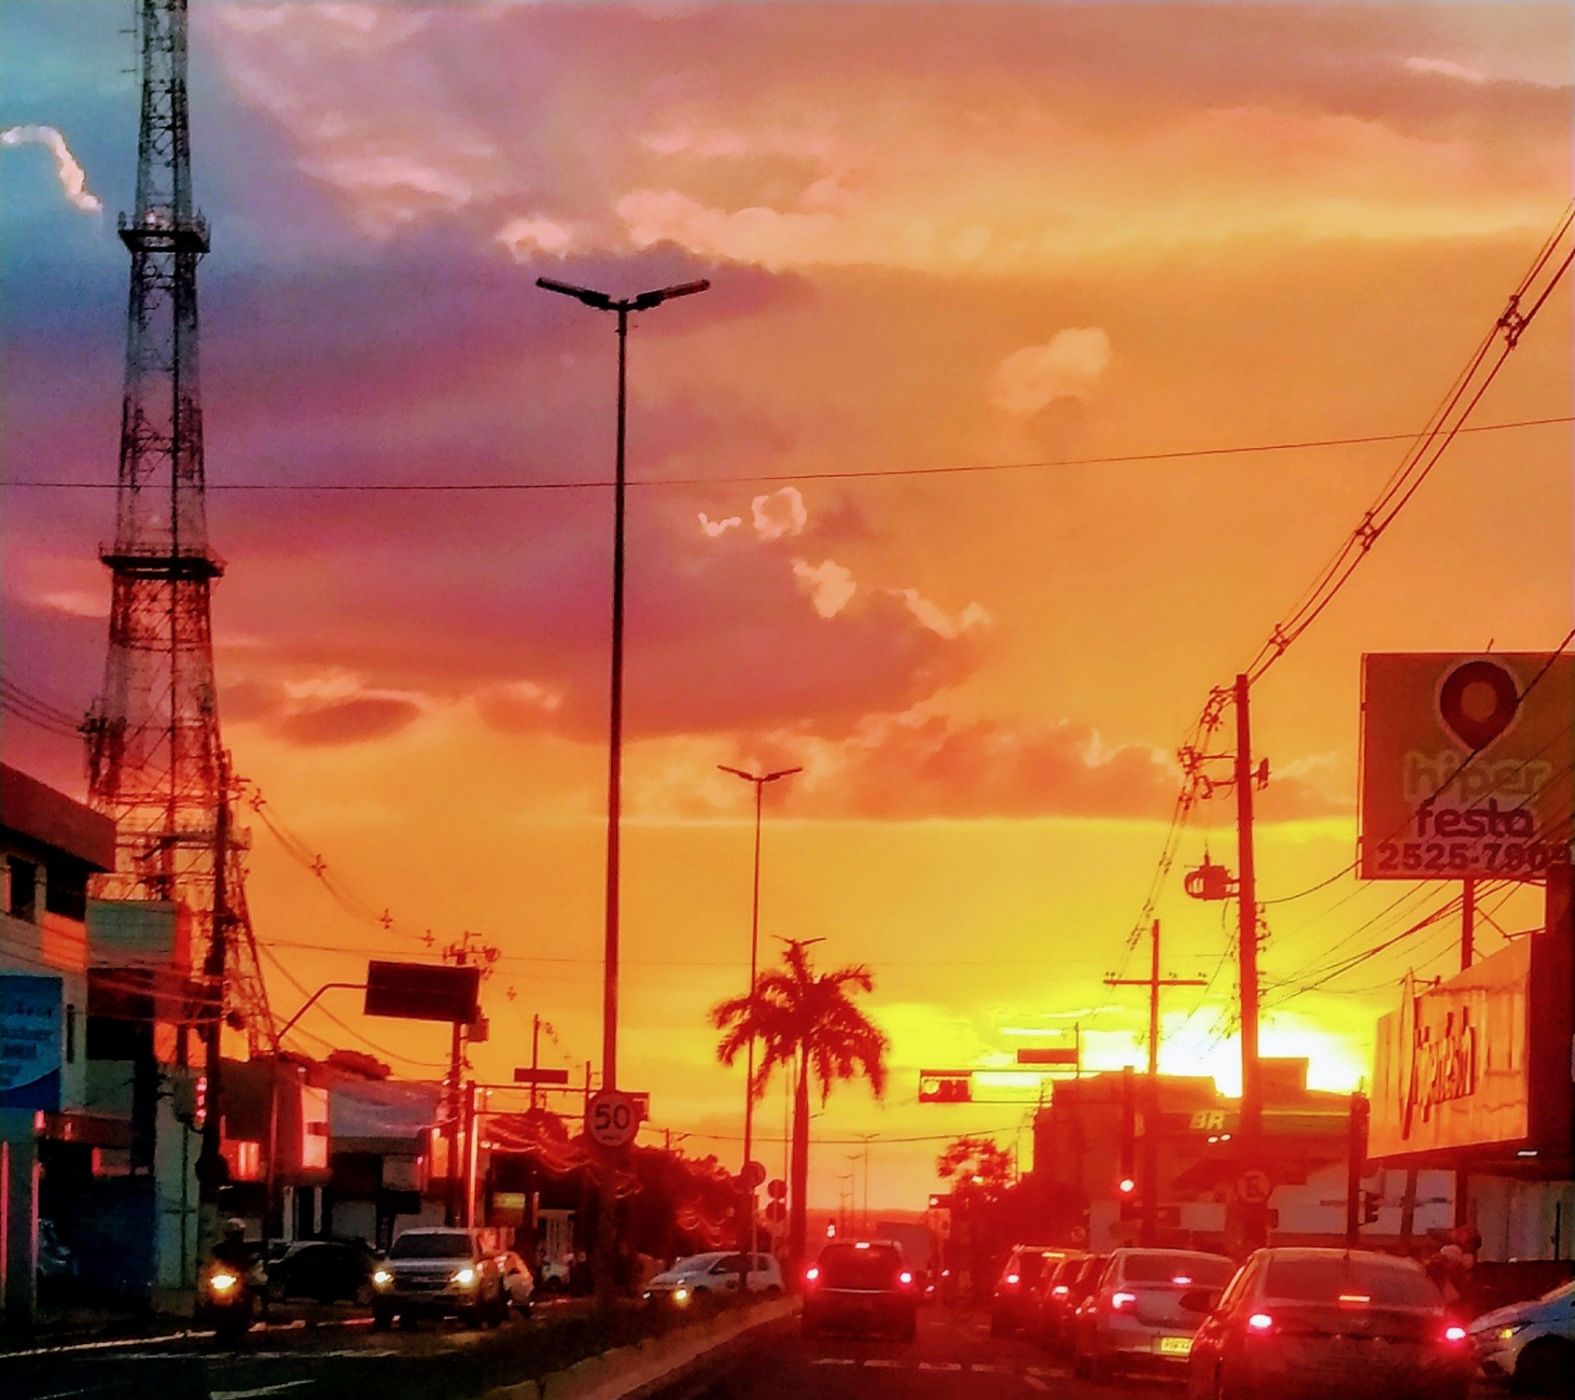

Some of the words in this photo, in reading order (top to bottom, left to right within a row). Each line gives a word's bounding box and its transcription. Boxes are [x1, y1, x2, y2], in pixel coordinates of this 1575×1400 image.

[1415, 797, 1534, 838] festa
[594, 1103, 631, 1130] 50
[1189, 1109, 1225, 1130] BR
